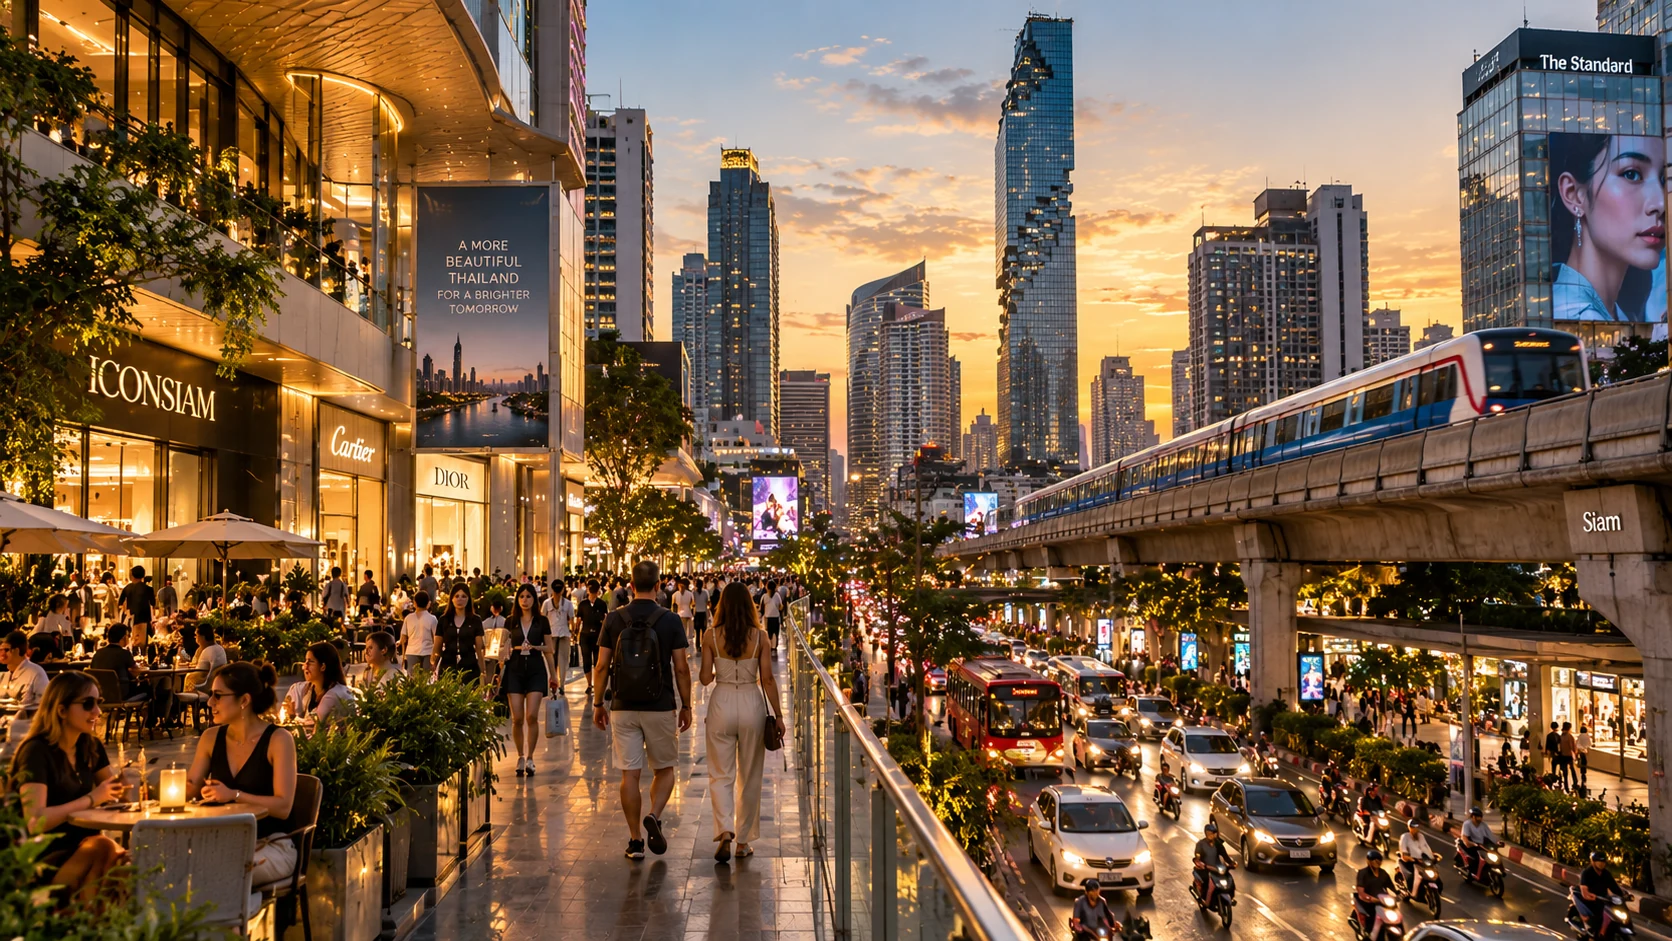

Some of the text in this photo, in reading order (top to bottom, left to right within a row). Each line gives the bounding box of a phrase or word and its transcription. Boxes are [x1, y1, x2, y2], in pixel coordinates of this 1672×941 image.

[1539, 54, 1633, 74] The Standard
[458, 239, 509, 251] A MORE
[446, 255, 522, 268] BEAUTIFUL
[448, 272, 519, 284] THAILAND
[437, 290, 530, 300] FOR A BRIGHTER
[449, 304, 519, 315] TOMORROW
[88, 354, 216, 422] ICONSIAM
[331, 425, 376, 463] Cartier
[434, 466, 470, 490] DIOR
[1582, 511, 1622, 533] Siam
